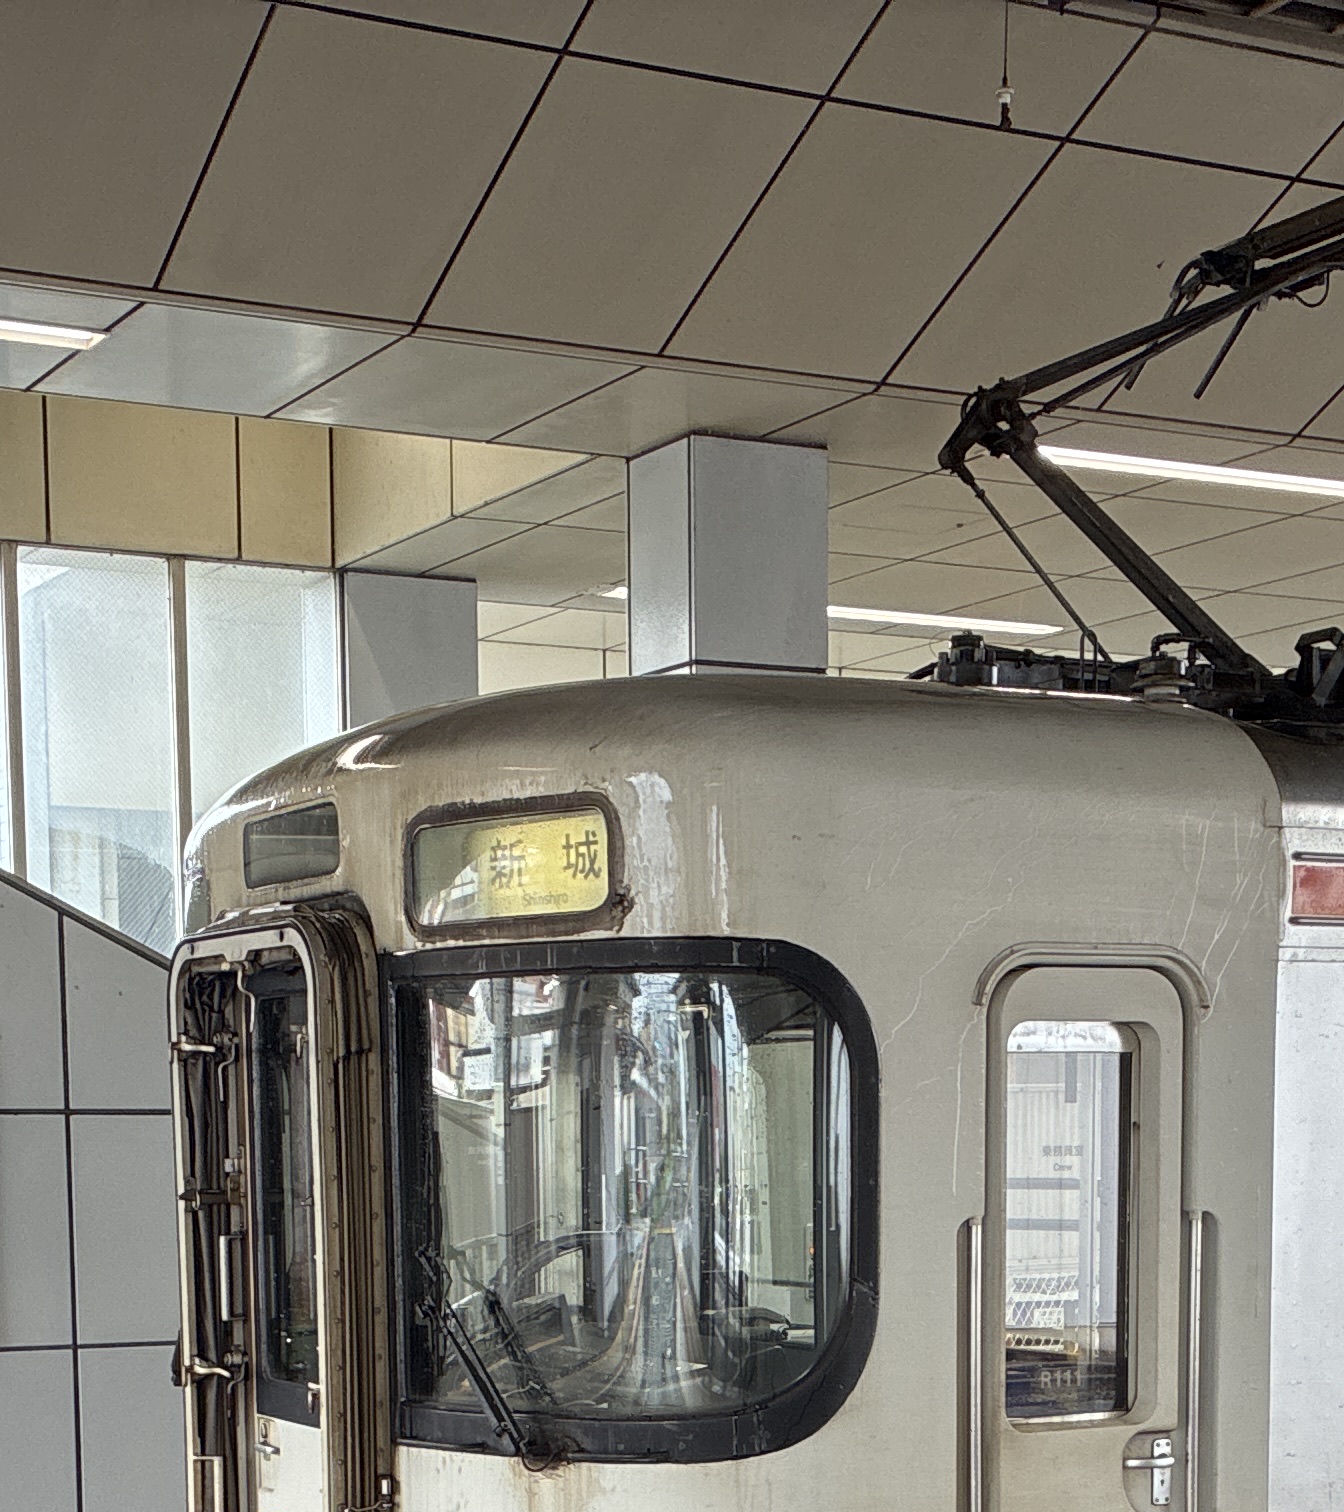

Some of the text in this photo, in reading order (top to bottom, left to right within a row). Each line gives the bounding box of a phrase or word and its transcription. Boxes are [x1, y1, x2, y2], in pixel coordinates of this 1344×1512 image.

[490, 830, 602, 889] 新城
[522, 890, 569, 907] Shinshiro
[1040, 1369, 1082, 1389] R111
